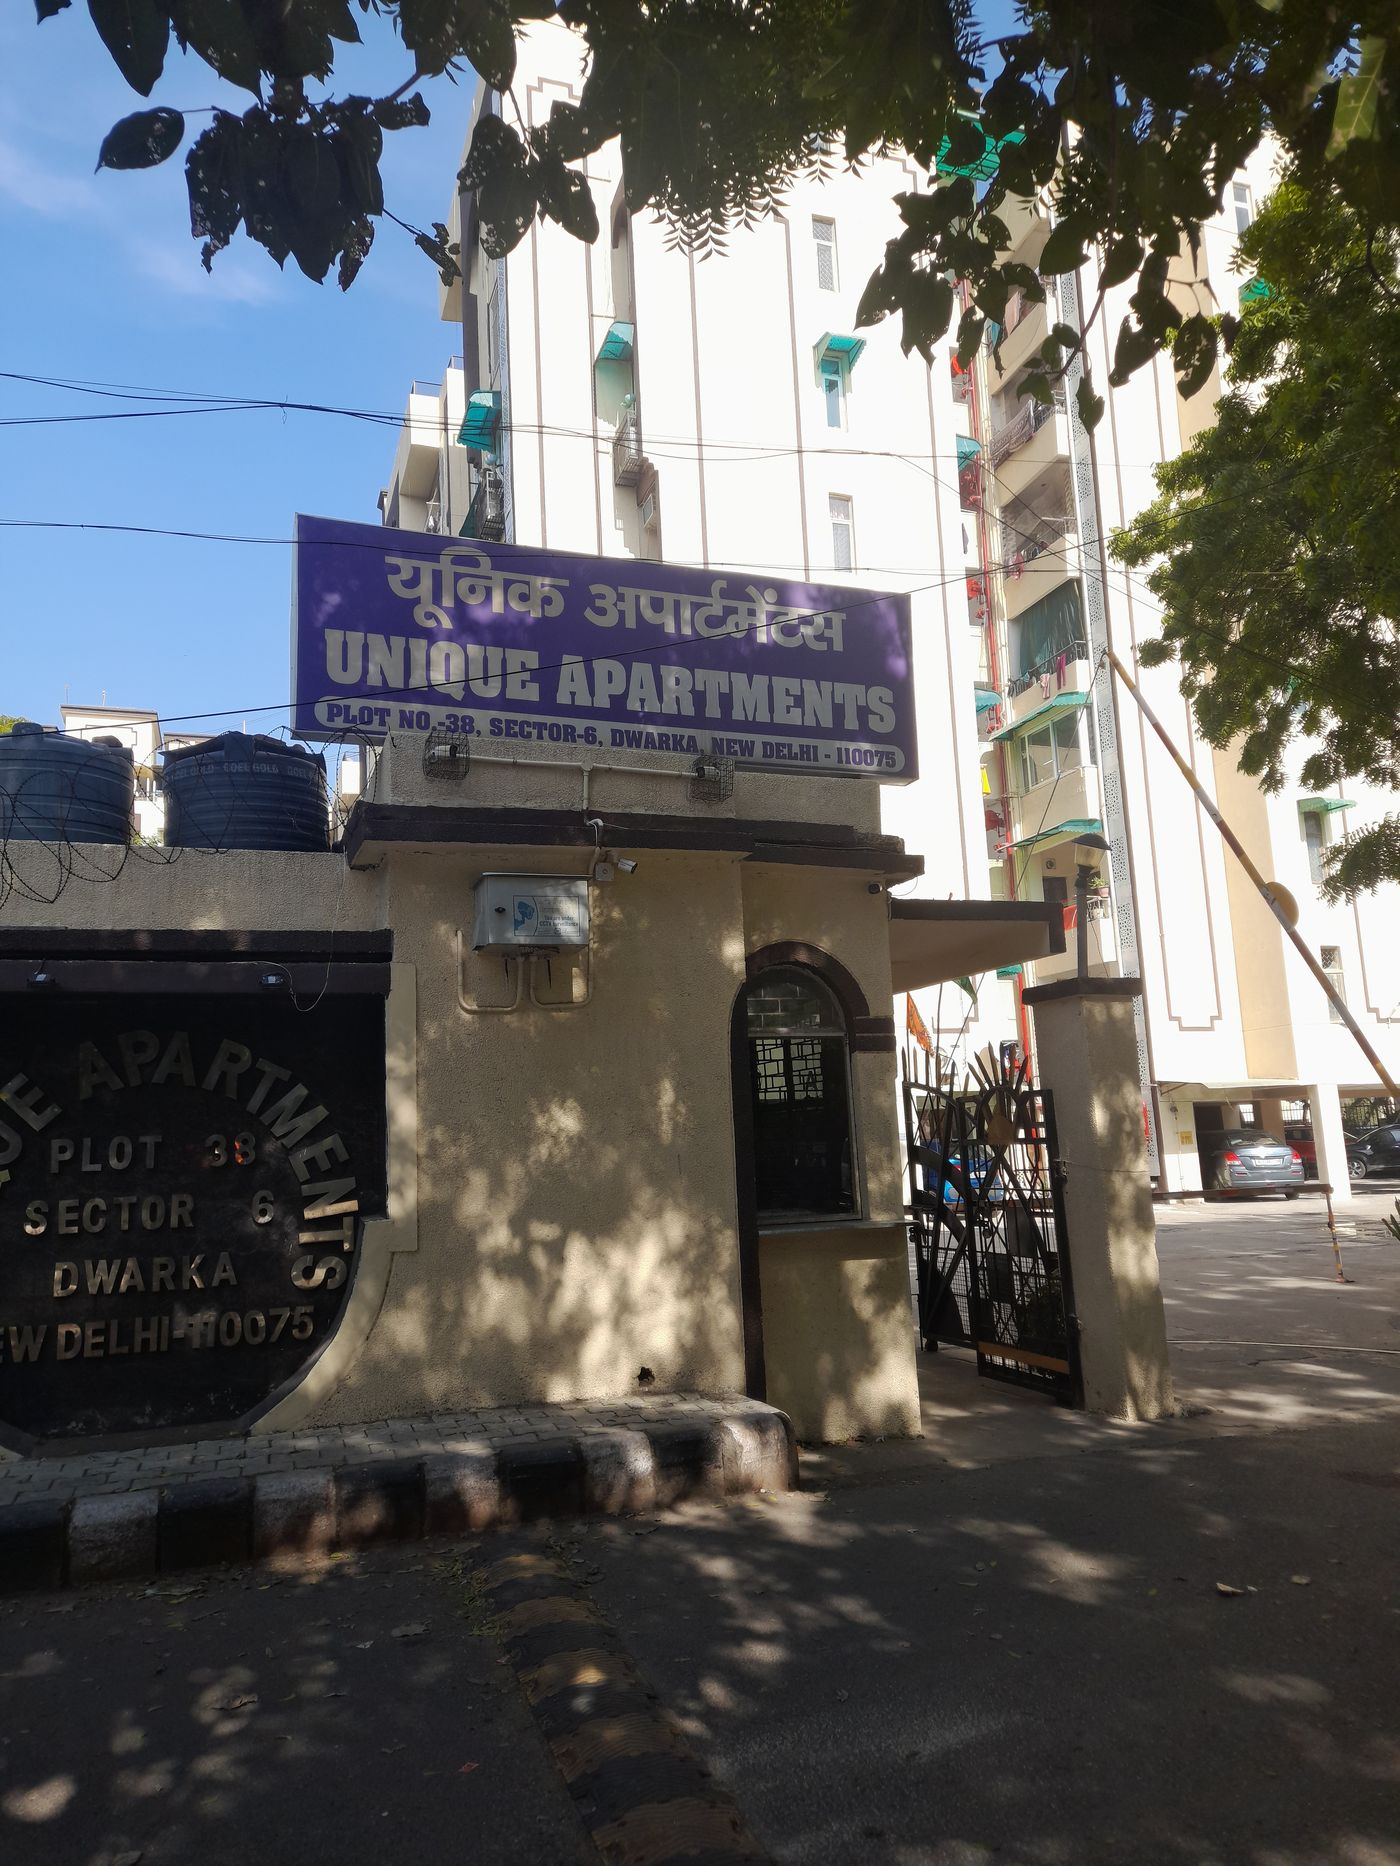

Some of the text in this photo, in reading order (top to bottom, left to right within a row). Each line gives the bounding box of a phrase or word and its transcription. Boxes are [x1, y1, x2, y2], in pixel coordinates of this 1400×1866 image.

[384, 546, 570, 629] यूनिक
[324, 628, 896, 734] UNIQUE APARTMENTS
[326, 703, 391, 727] PLOT
[711, 736, 756, 757] NEW
[762, 741, 819, 763] DELHI
[837, 747, 897, 769] 110075
[50, 1131, 256, 1173] PLOT 38
[79, 1029, 360, 1291] APARTMENTS
[23, 1189, 275, 1236] SECTOR 6
[53, 1251, 238, 1298] DWARKA
